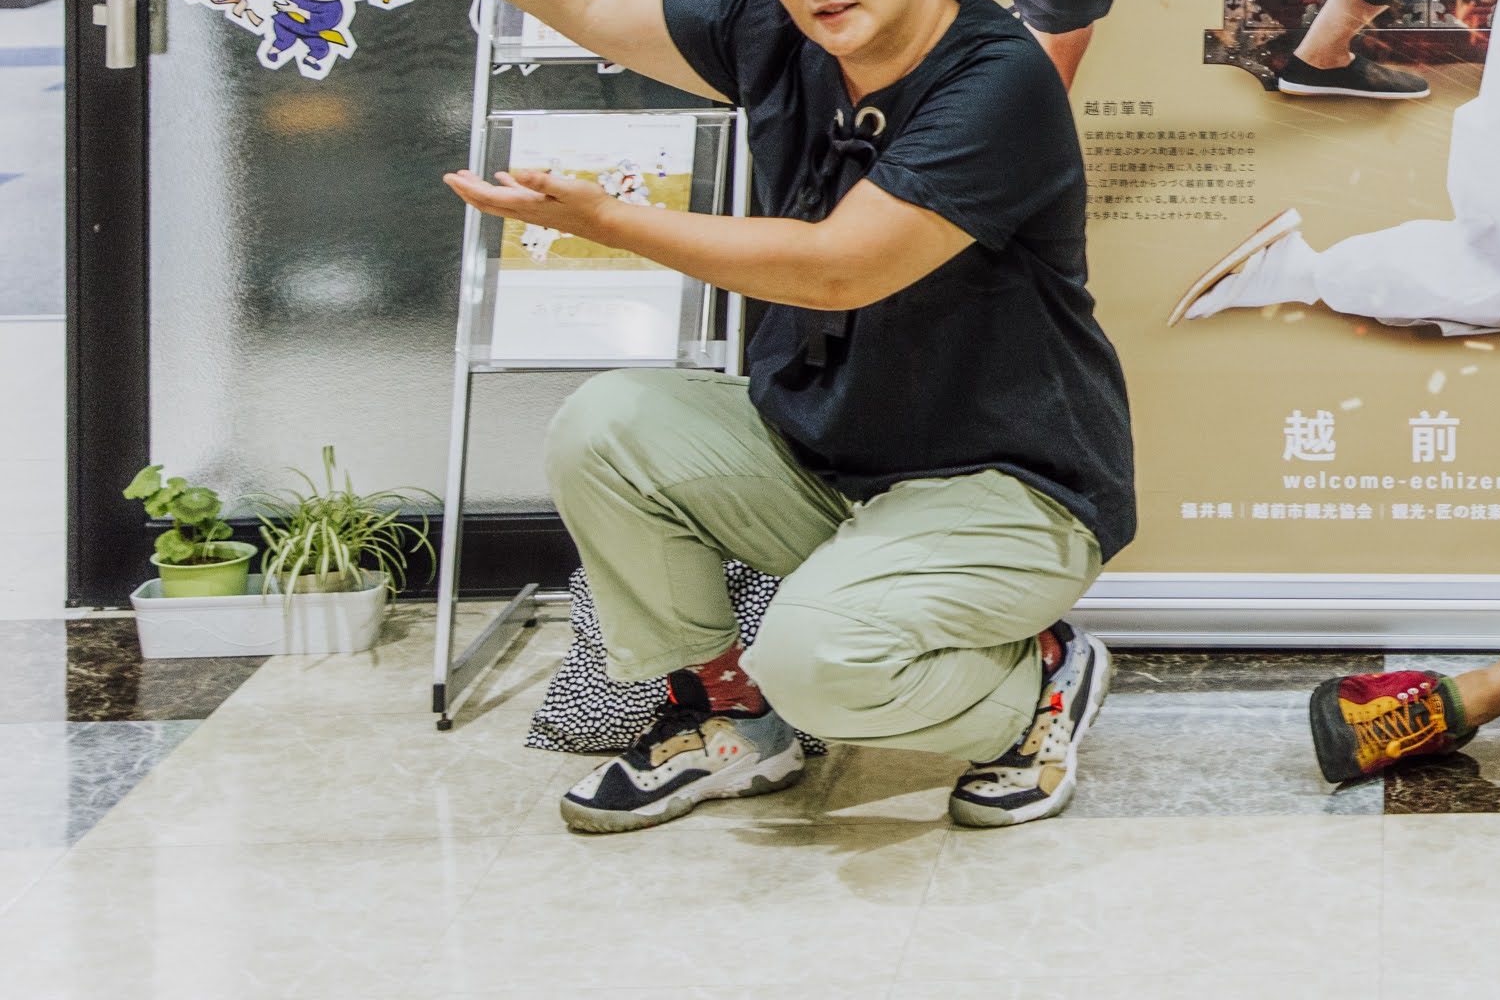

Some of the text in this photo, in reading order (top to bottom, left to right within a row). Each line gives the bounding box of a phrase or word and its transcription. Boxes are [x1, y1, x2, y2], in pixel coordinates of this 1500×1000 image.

[1083, 100, 1154, 116] 越前箪笥
[1180, 502, 1235, 520] 福井県
[1251, 502, 1374, 520] 越前市観光協会
